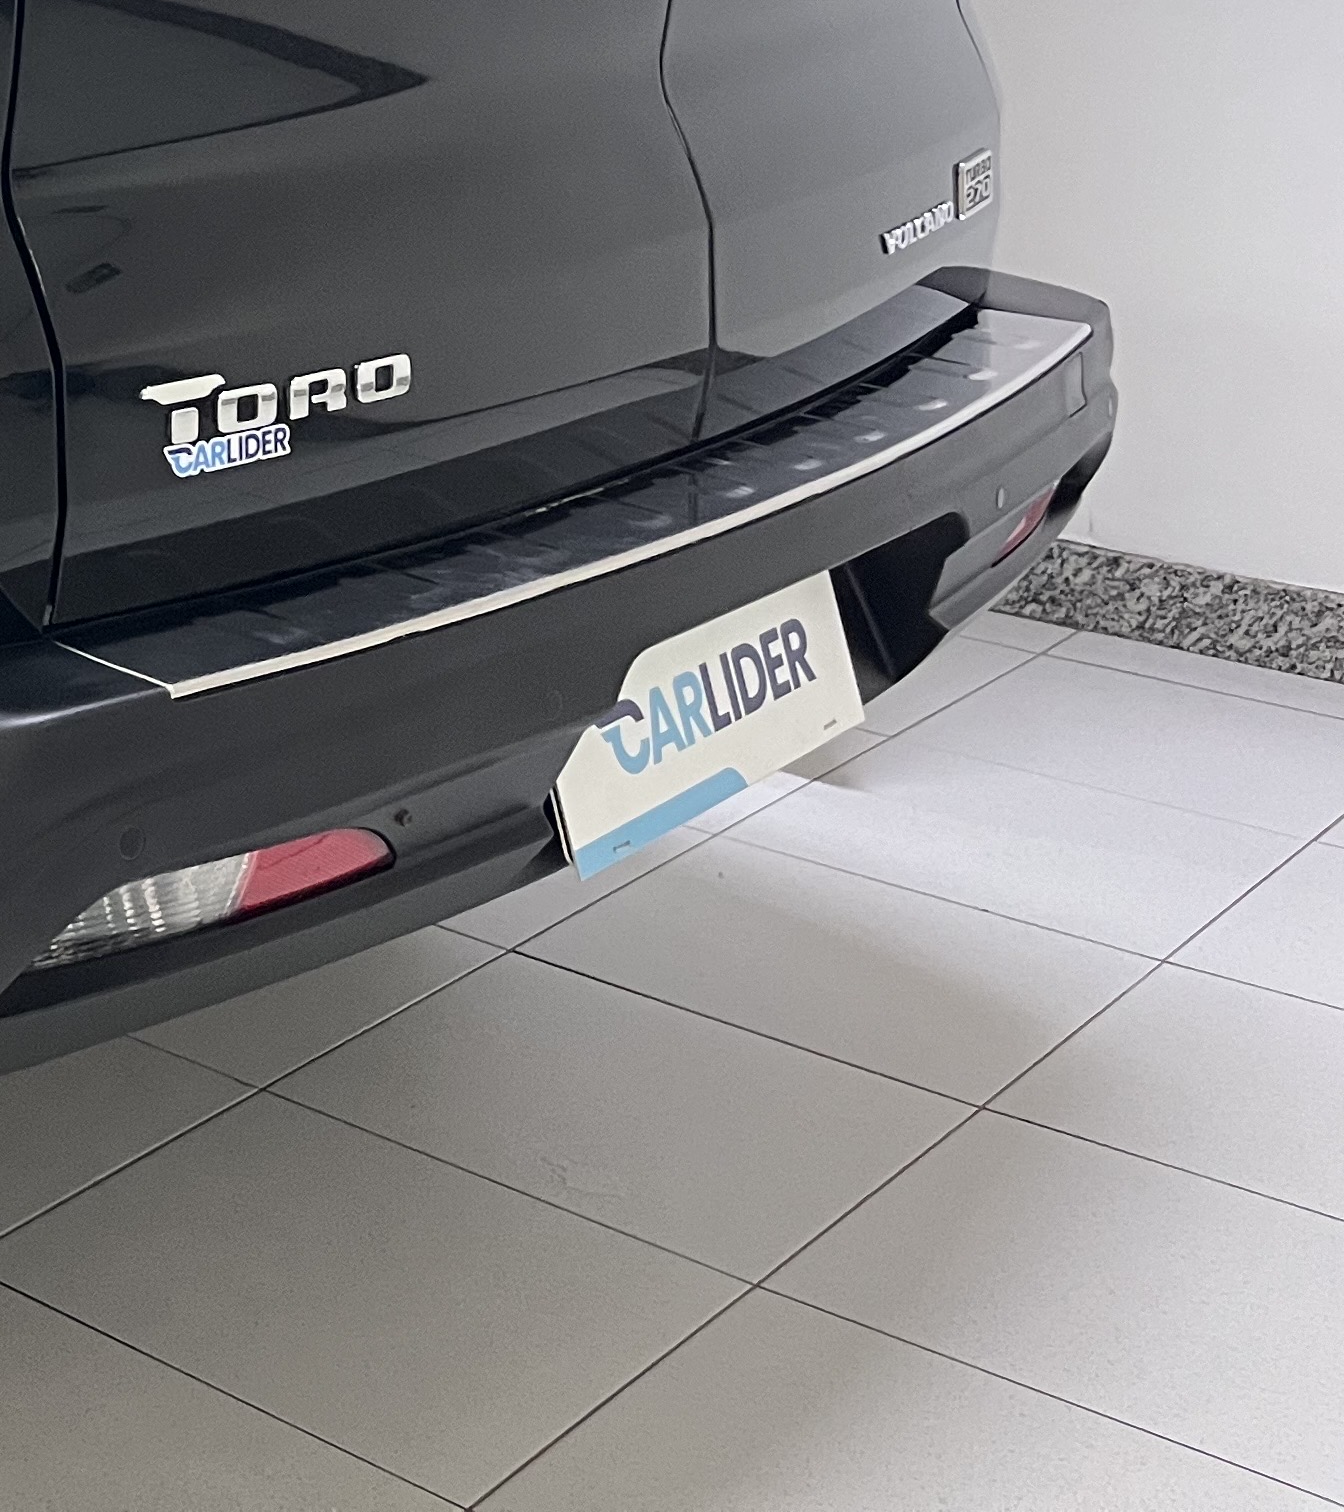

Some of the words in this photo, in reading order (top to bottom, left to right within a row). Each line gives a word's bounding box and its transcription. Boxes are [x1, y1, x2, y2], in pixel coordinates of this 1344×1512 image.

[965, 176, 991, 209] 270
[880, 200, 954, 255] VOLCANO
[139, 353, 412, 444] TORO
[168, 427, 288, 474] CARLIDER
[594, 618, 817, 775] CARLIDER
